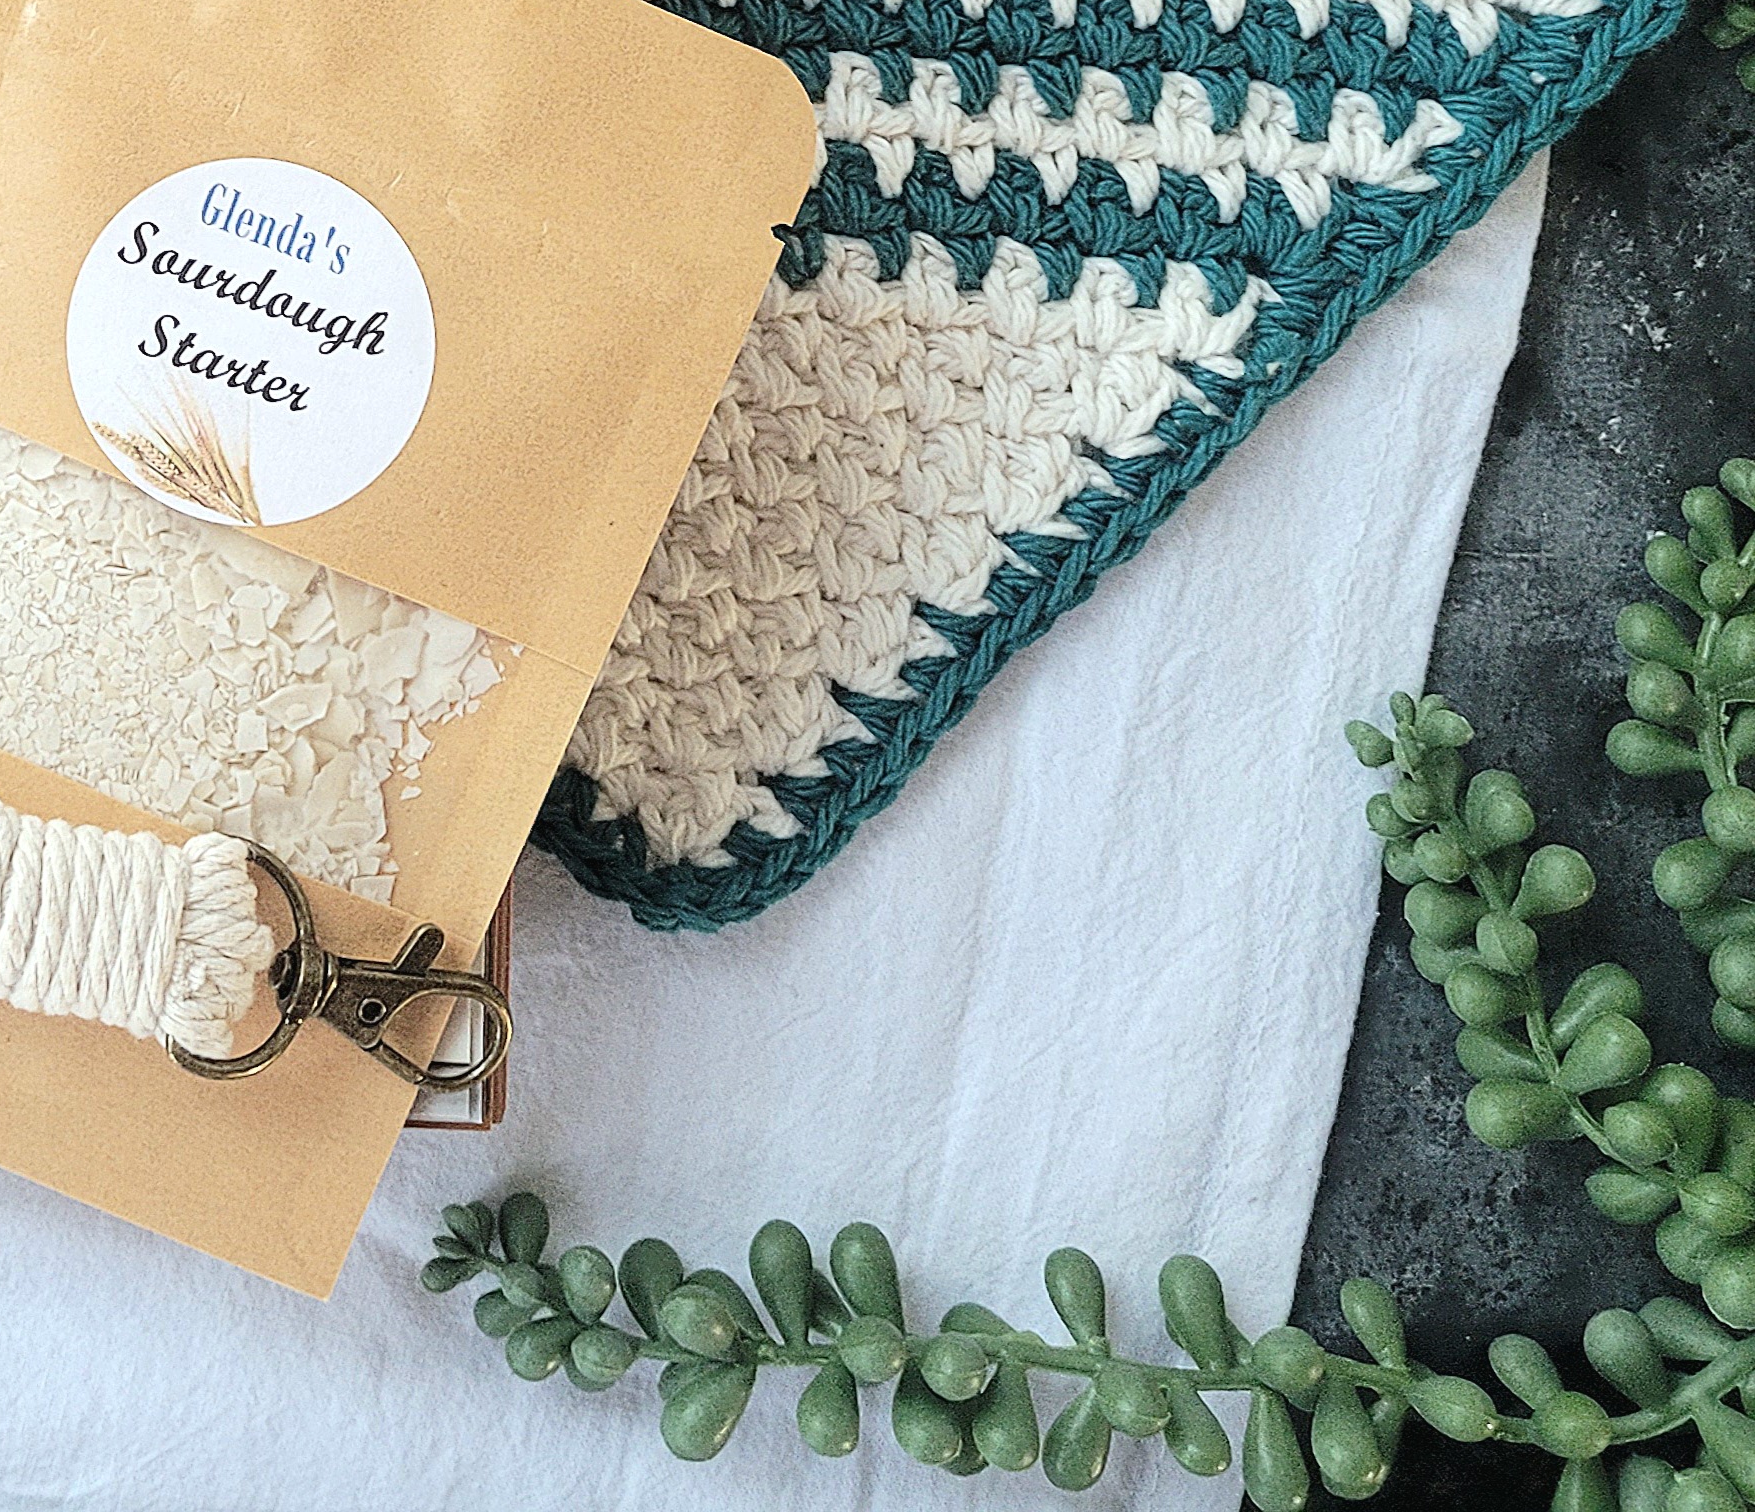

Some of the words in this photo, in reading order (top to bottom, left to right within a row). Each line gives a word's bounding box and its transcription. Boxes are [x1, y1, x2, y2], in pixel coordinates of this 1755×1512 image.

[201, 182, 352, 276] Glenda's
[117, 221, 390, 355] Sourdough
[138, 314, 309, 412] Starter
